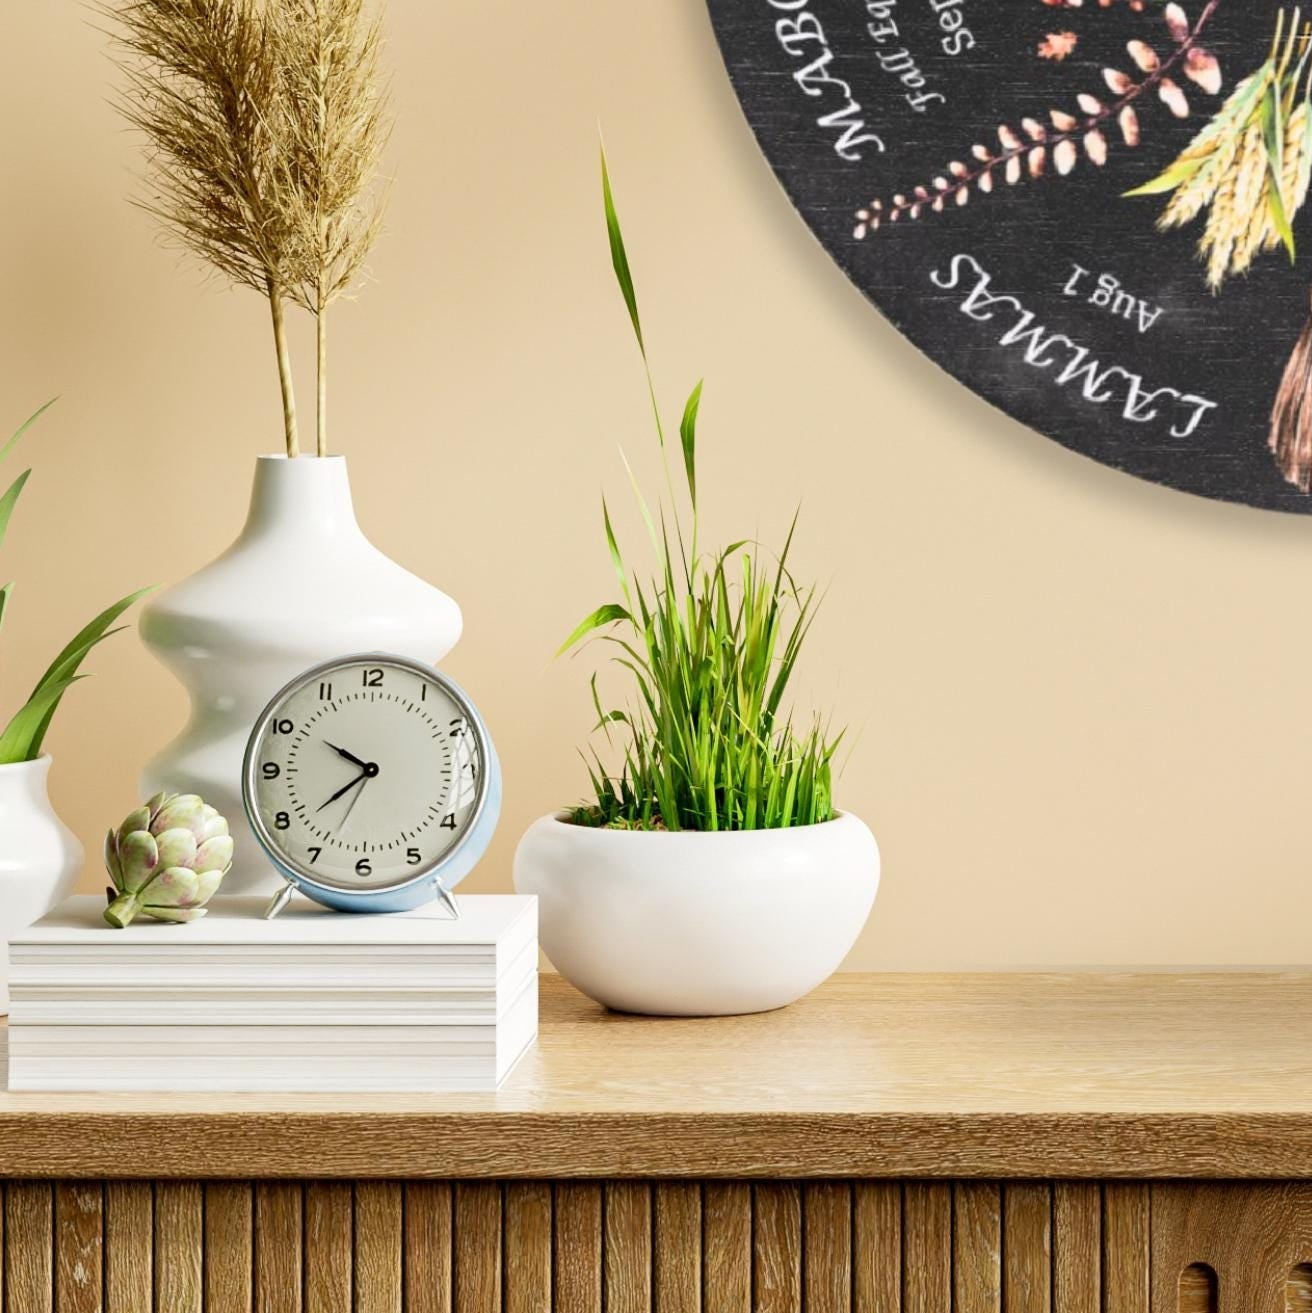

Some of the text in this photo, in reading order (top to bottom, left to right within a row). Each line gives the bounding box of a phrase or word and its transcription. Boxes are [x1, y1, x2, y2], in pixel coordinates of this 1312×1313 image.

[876, 48, 946, 113] Fall
[1063, 263, 1164, 333] Aug 1
[930, 254, 1218, 438] LAMMAS
[362, 669, 384, 687] 12
[319, 683, 332, 701] 11
[421, 683, 427, 701] 1
[272, 718, 294, 735] 10
[262, 762, 280, 780] 9
[274, 811, 291, 830] 8
[439, 813, 457, 831] 4
[307, 847, 322, 865] 7
[406, 848, 421, 865] 5
[355, 858, 373, 877] 6
